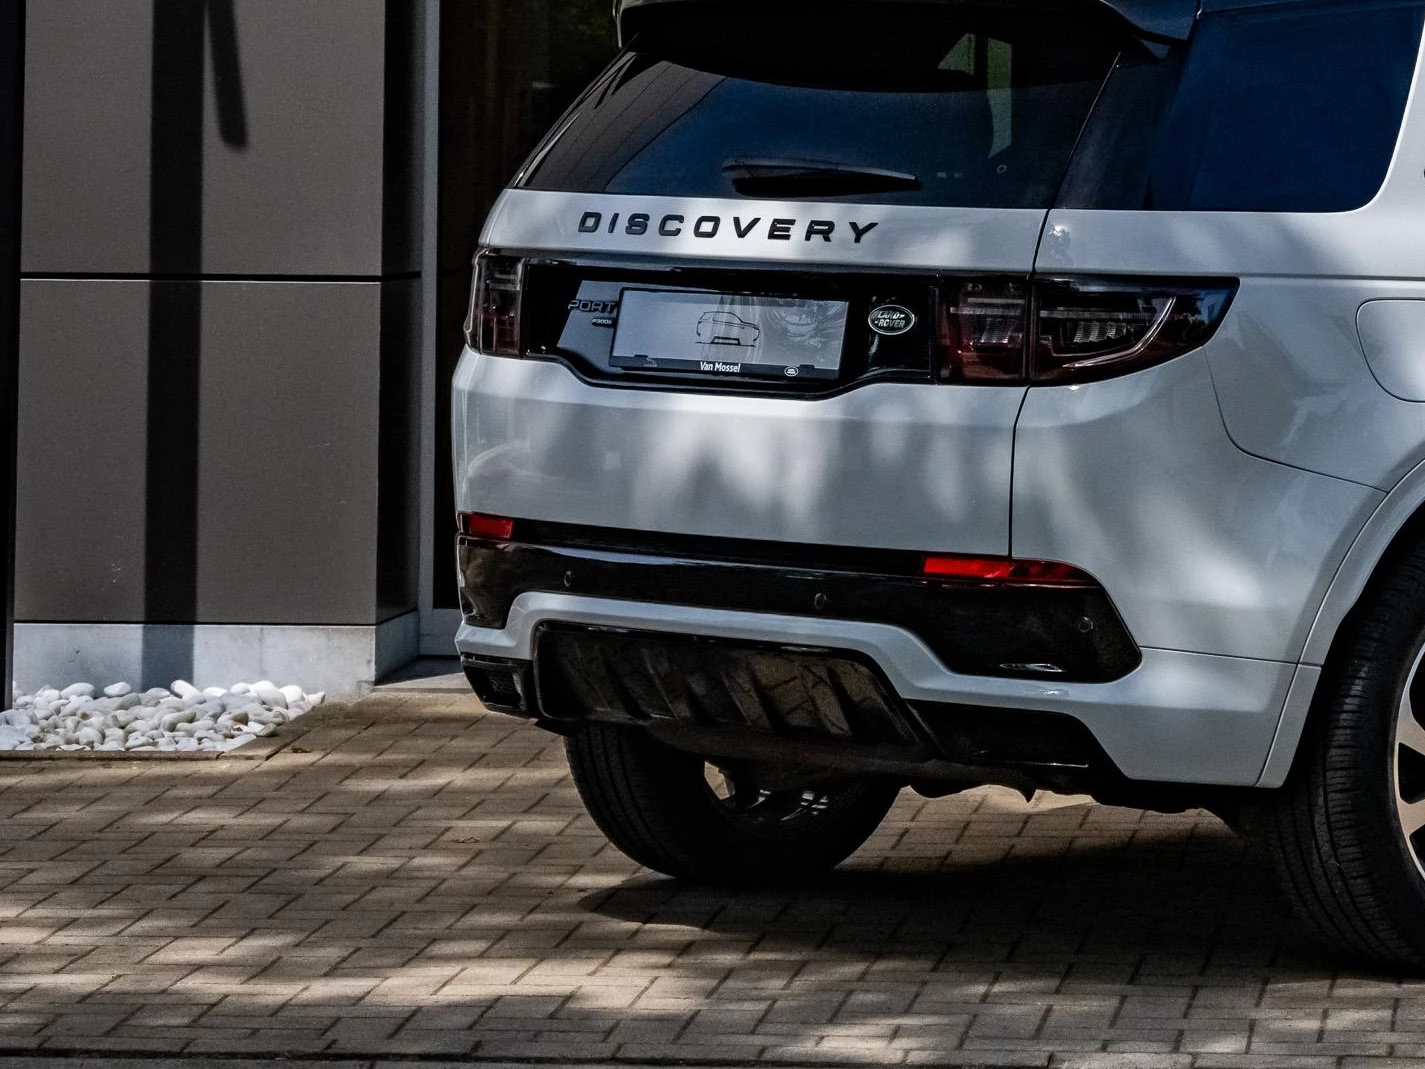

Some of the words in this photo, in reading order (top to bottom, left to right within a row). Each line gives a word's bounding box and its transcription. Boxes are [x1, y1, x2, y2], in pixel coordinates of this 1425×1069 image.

[577, 211, 879, 244] DISCOVERY
[567, 300, 617, 312] PORT
[700, 362, 713, 371] Van
[714, 362, 741, 373] Mossel
